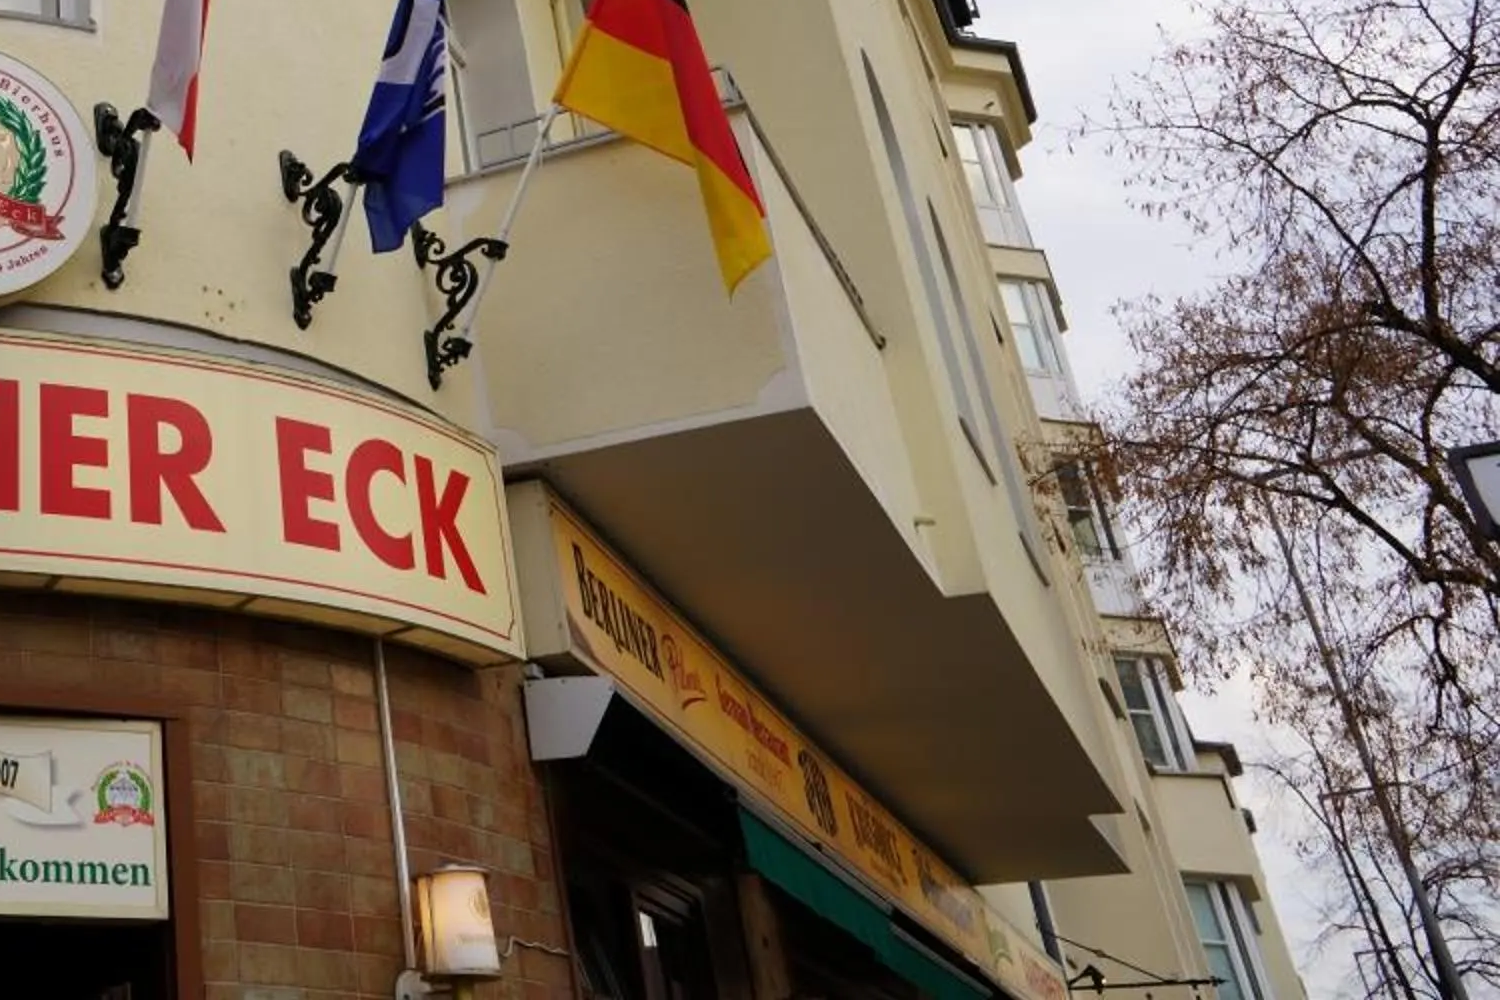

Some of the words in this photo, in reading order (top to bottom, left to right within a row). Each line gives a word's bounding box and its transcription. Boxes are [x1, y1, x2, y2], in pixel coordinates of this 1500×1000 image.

[0, 78, 65, 158] Bierhaus
[7, 245, 49, 271] Jahren
[276, 416, 488, 596] ECK
[571, 540, 665, 683] BERLINER
